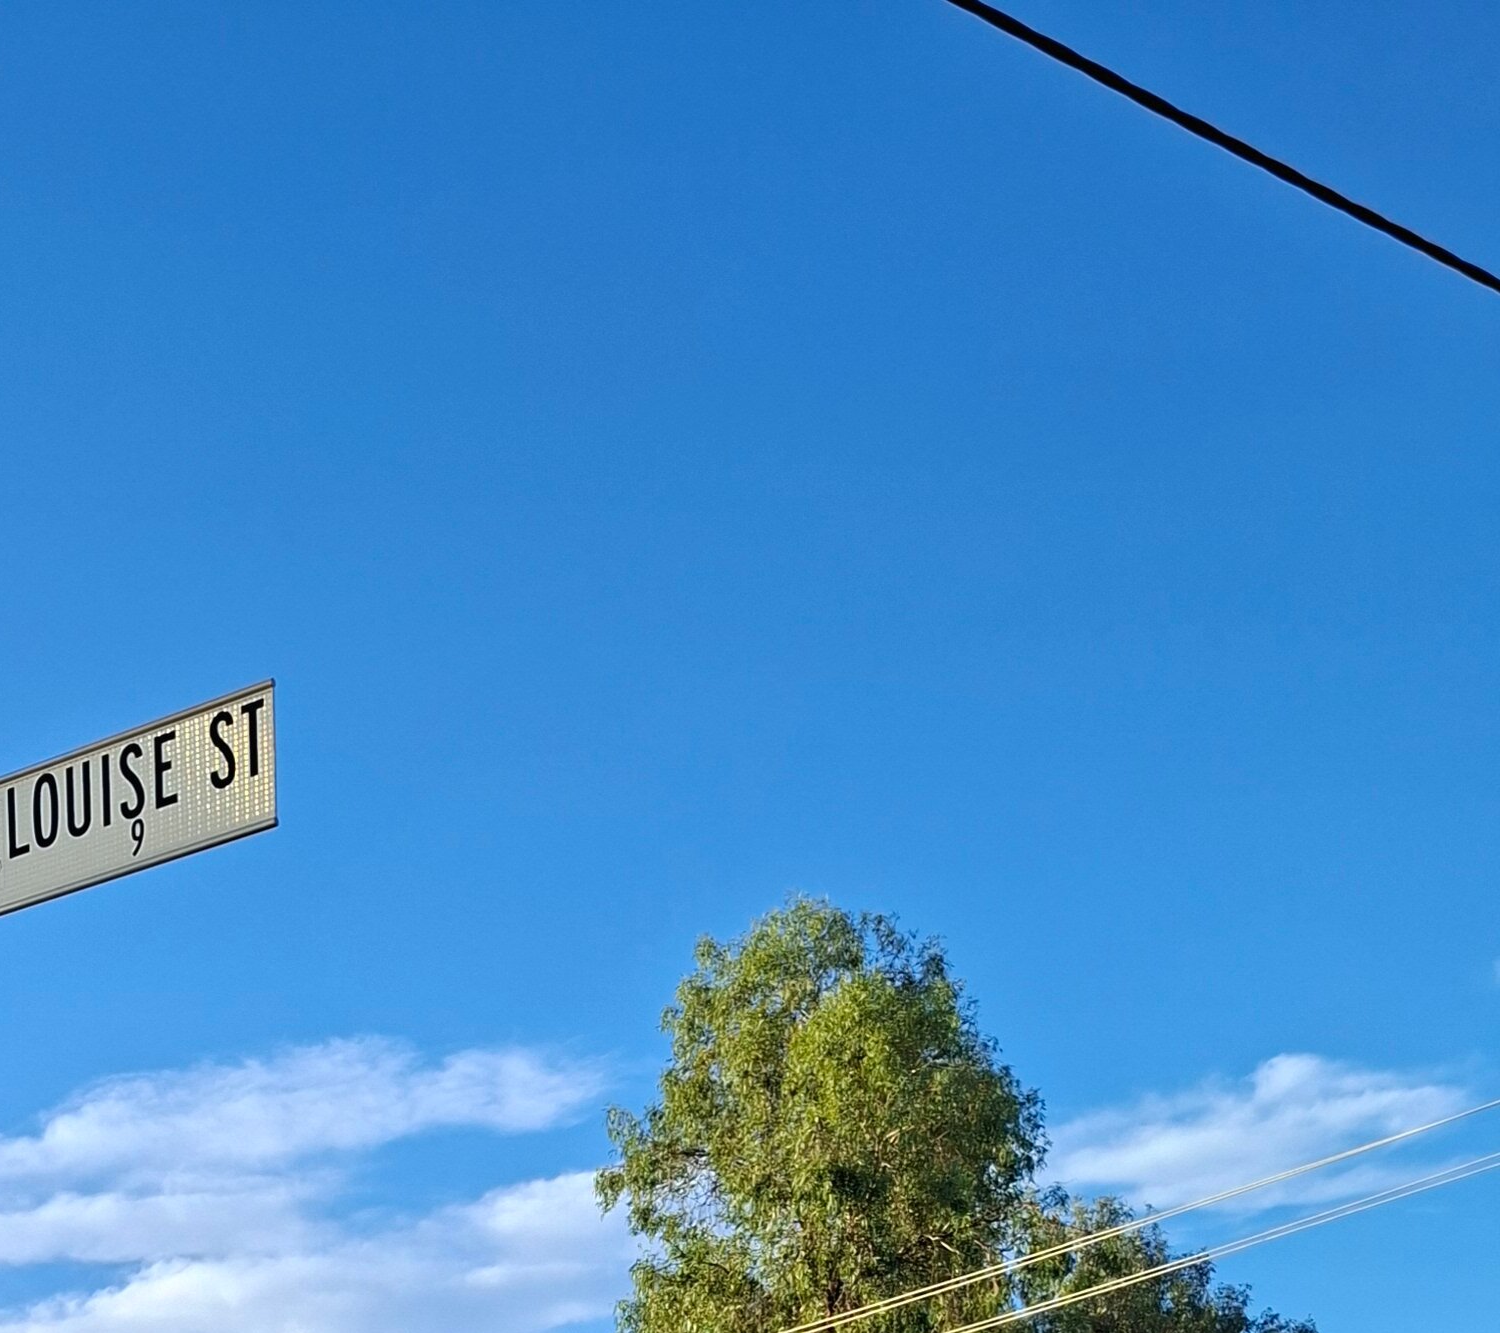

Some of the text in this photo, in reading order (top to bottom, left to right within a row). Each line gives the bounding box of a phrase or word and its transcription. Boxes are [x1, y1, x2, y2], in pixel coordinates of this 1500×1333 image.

[6, 697, 265, 860] LOUISE ST
[130, 817, 145, 857] 9
